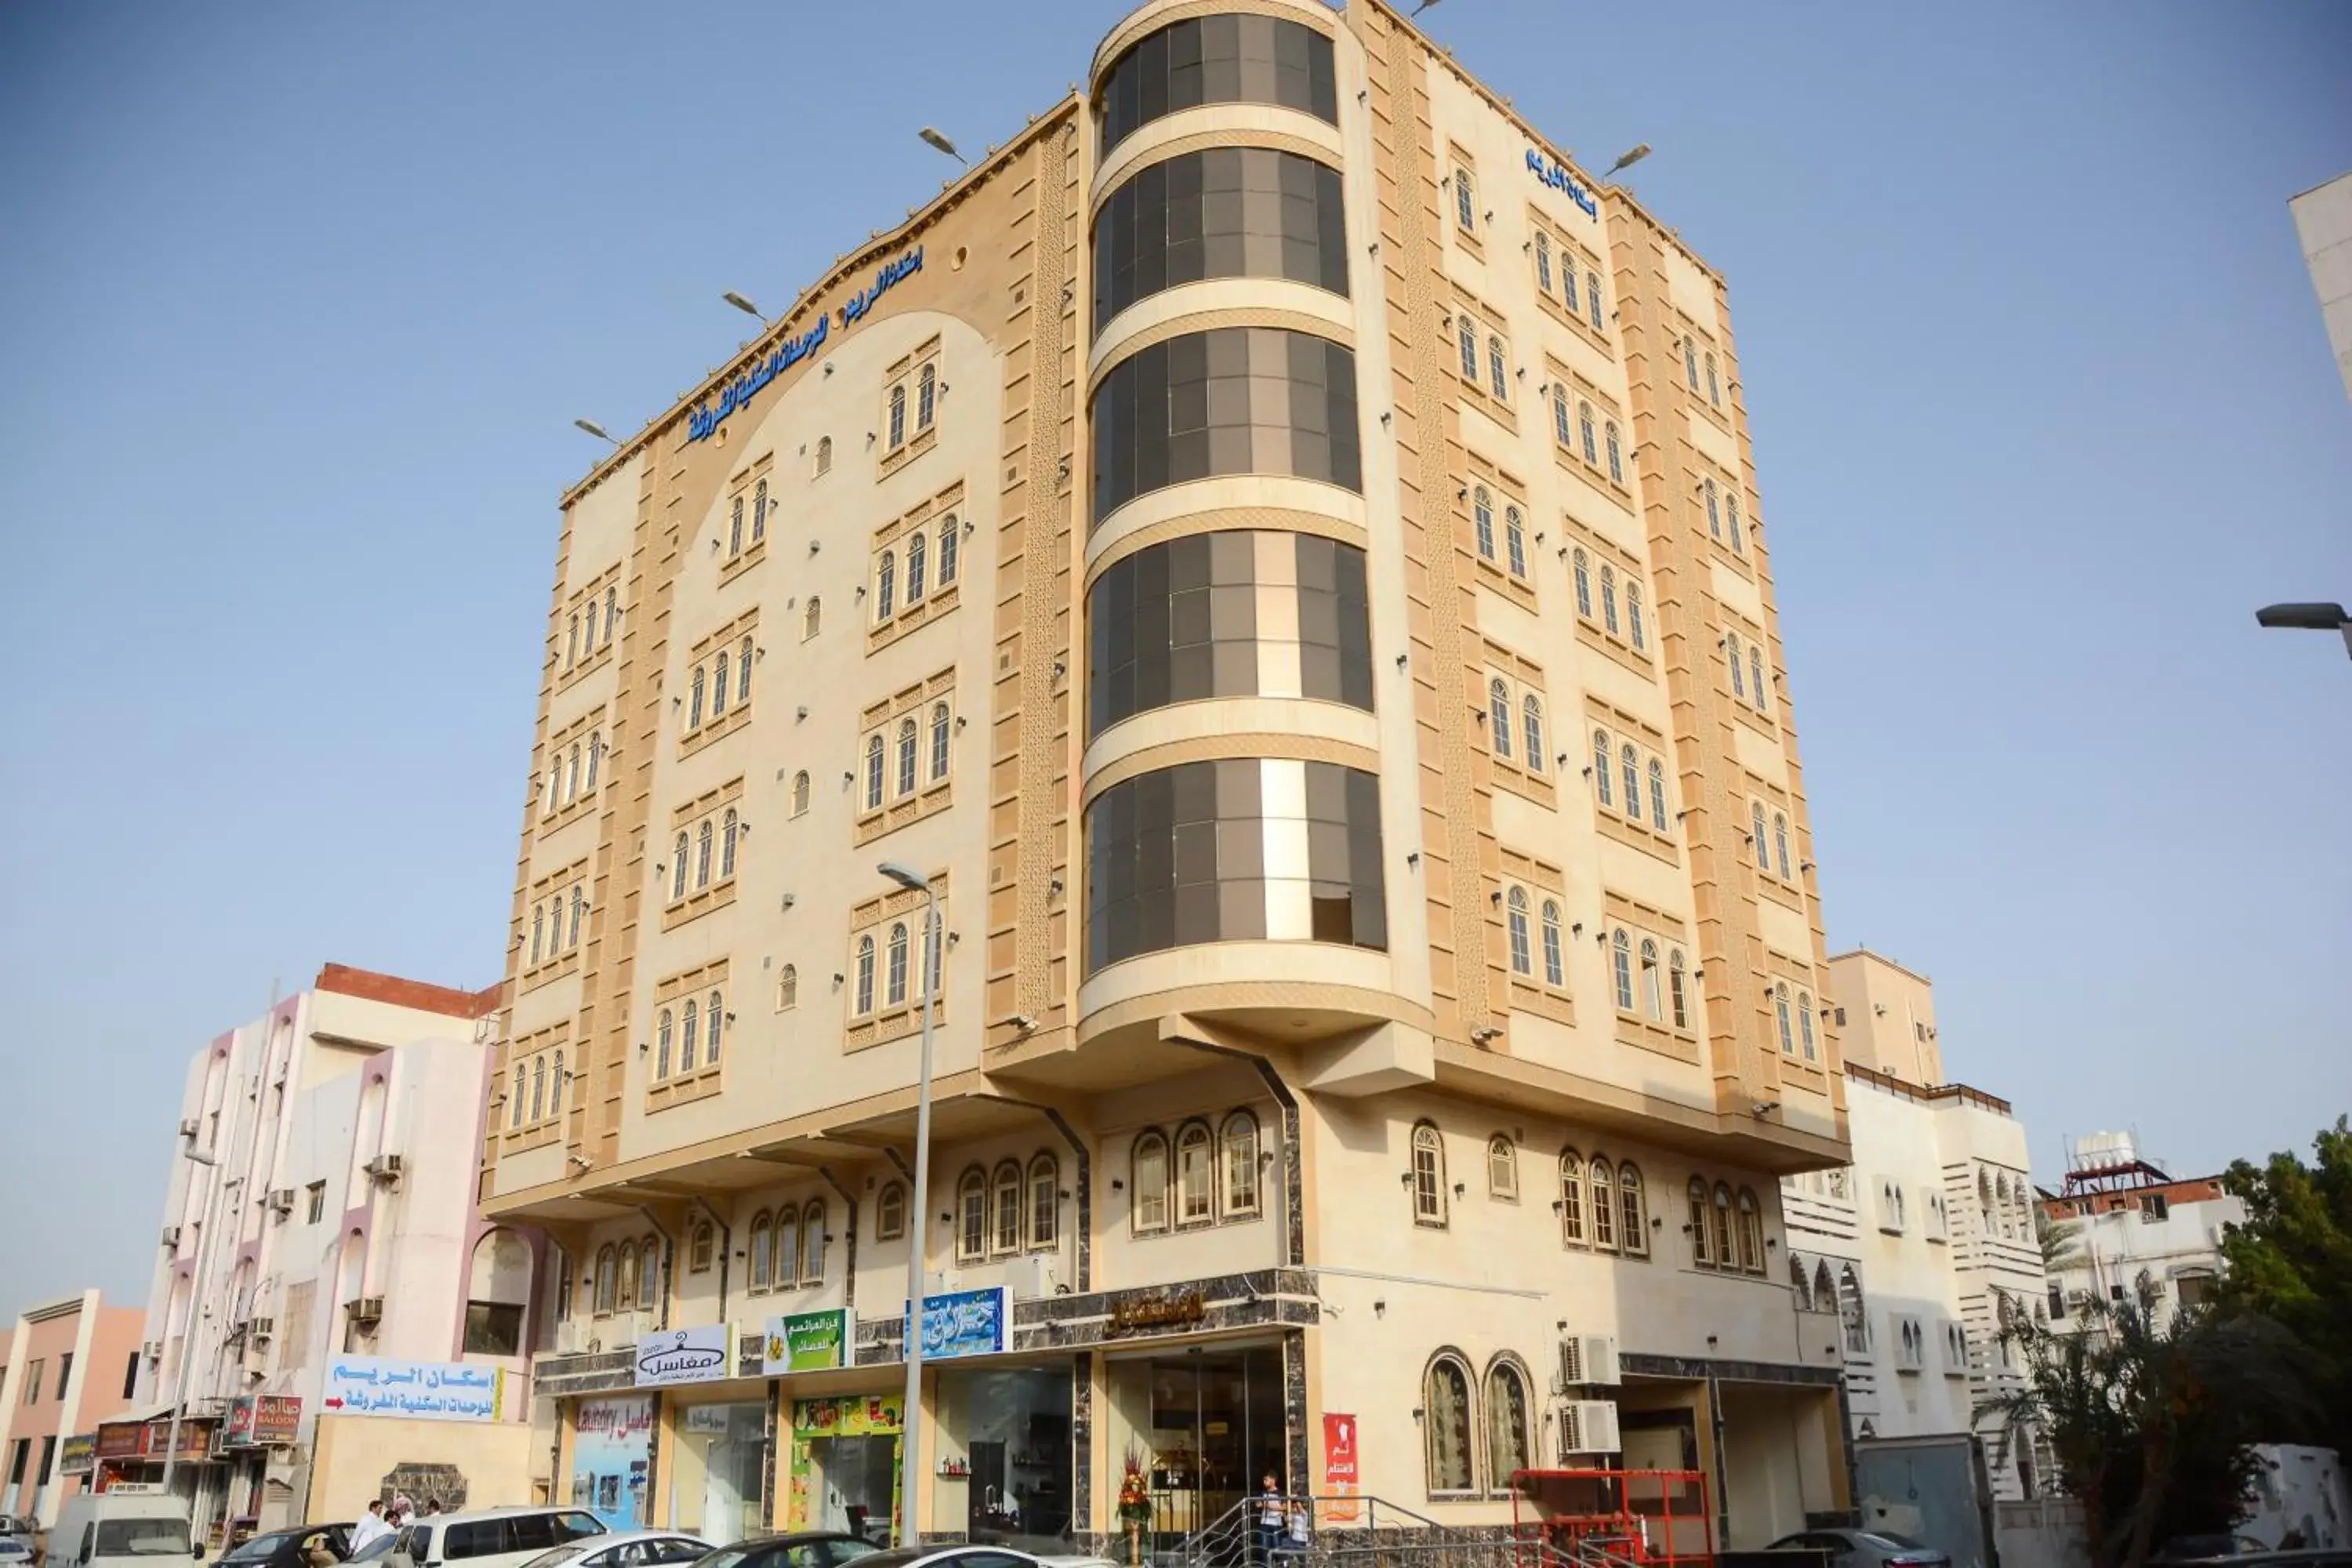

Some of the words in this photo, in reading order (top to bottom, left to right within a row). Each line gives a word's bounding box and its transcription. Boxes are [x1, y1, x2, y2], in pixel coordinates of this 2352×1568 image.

[334, 1365, 423, 1386] الريم
[650, 1356, 712, 1376] مغاسل
[257, 1397, 300, 1415] صالون
[398, 1393, 448, 1414] السكنية
